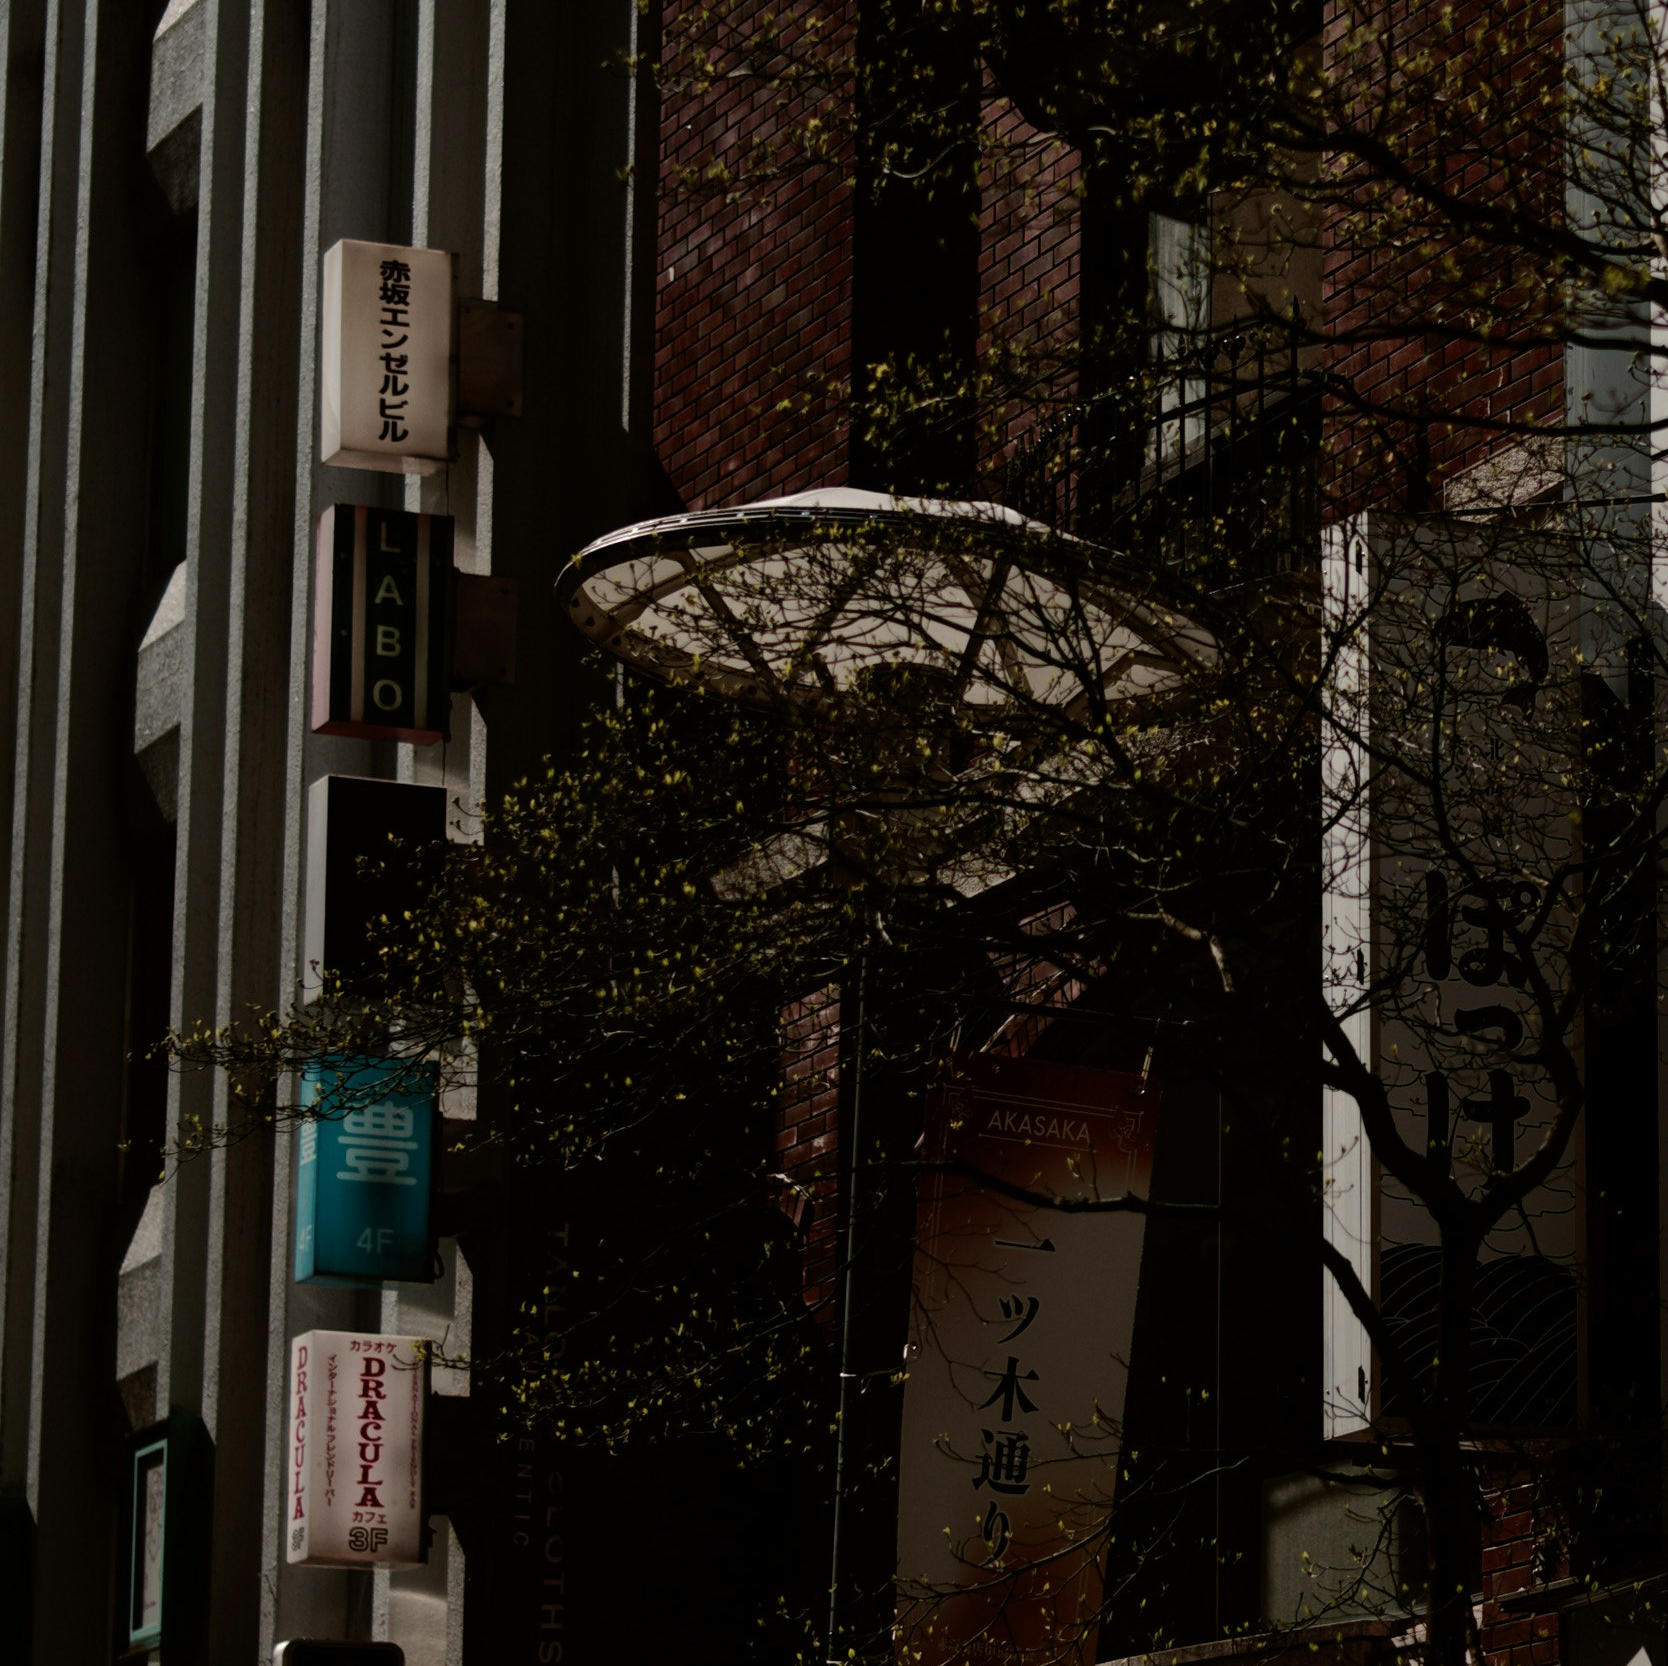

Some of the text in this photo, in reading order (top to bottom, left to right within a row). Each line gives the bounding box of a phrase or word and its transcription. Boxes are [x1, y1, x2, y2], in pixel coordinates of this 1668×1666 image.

[379, 260, 410, 443] 赤坂エンゼルビル
[373, 521, 404, 713] LABO
[988, 1109, 1091, 1148] AKASAKA
[356, 1226, 394, 1254] 4F
[350, 1340, 397, 1354] カラオケ
[293, 1346, 307, 1520] DRACULA
[355, 1357, 386, 1507] DRACULA
[972, 1239, 1055, 1567] 一ツ木通り
[349, 1527, 388, 1552] 3F
[352, 1511, 387, 1524] カフェ
